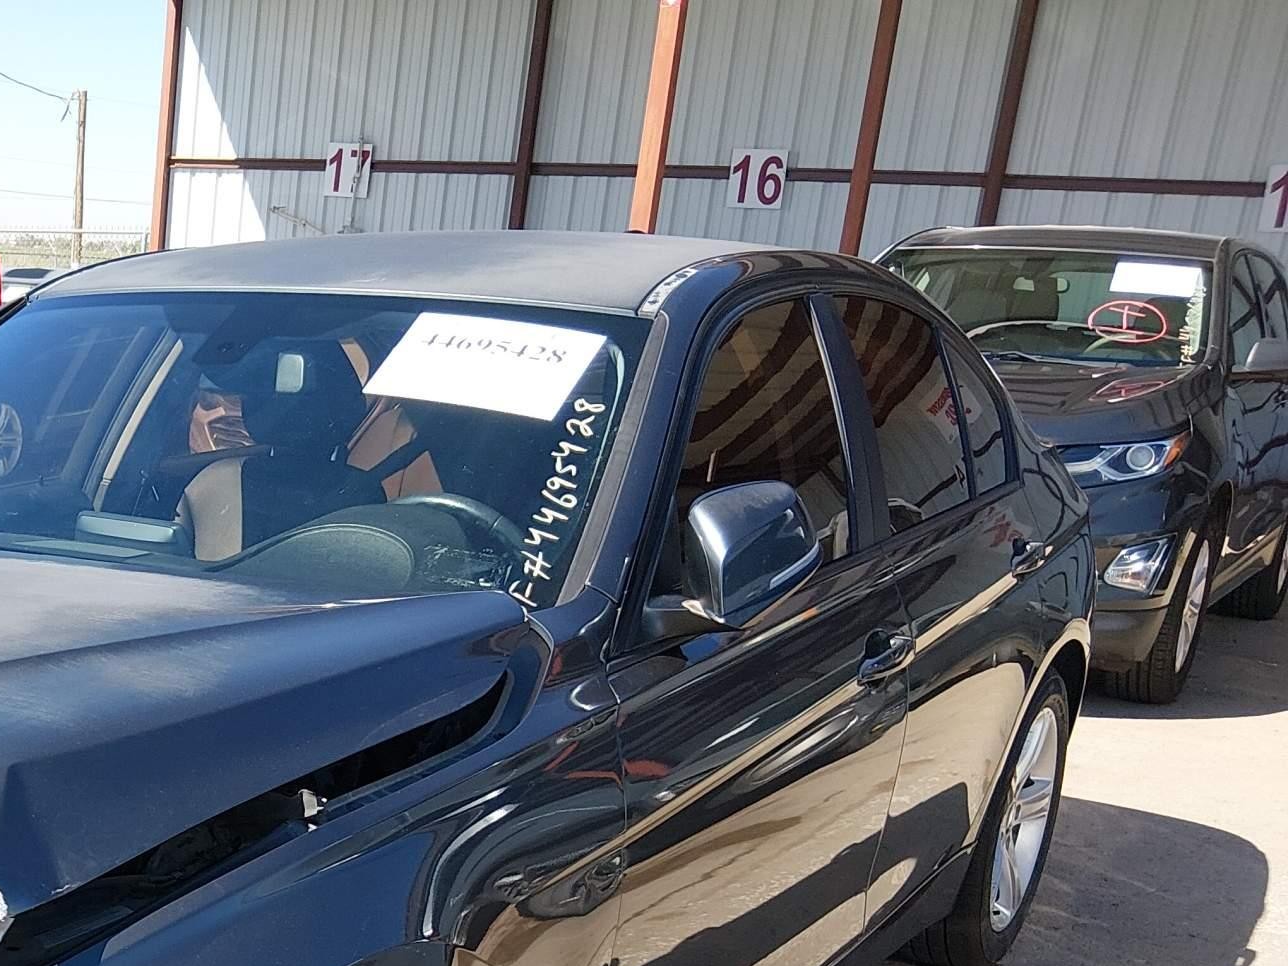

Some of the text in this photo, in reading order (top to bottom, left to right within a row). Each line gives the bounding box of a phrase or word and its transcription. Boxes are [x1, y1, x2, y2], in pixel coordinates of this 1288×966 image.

[329, 148, 371, 193] 17
[733, 155, 784, 205] 16
[1270, 171, 1288, 228] 1
[421, 332, 568, 365] 44695428
